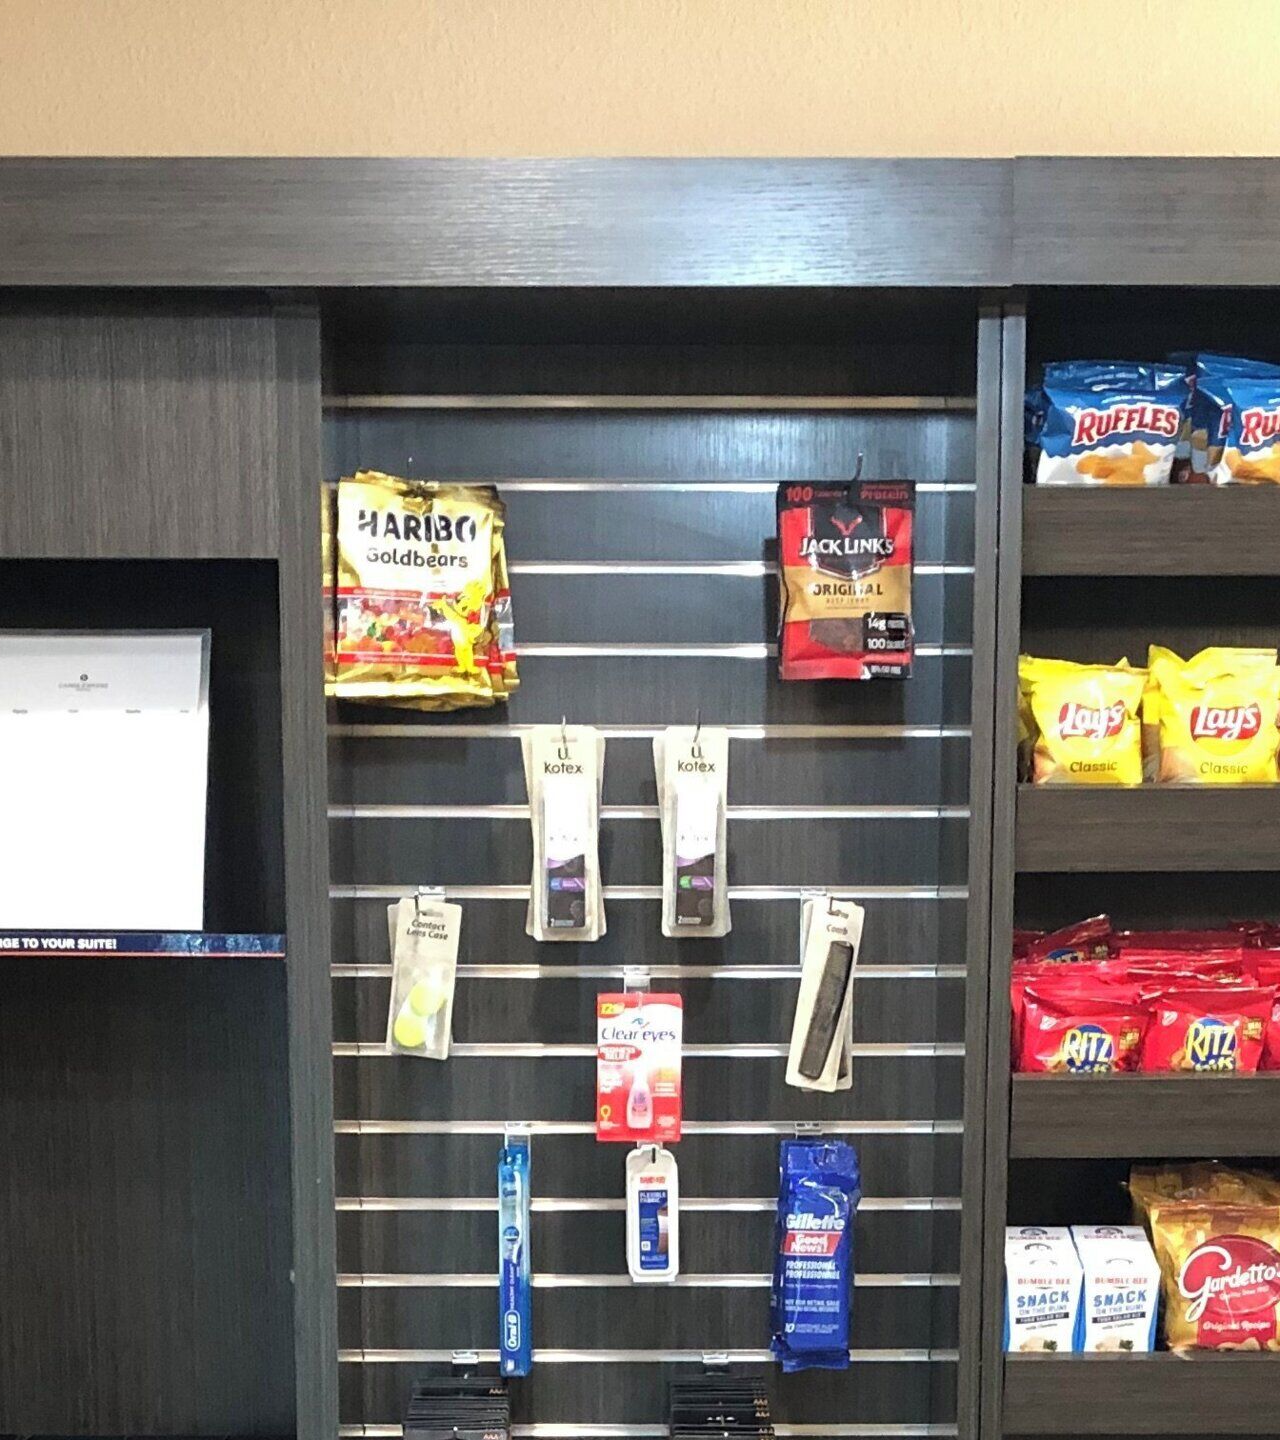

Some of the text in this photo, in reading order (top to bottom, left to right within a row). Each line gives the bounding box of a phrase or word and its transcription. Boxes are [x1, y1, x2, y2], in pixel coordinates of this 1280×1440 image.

[1074, 405, 1180, 445] RUFFLES
[357, 509, 477, 543] HARIBO
[800, 537, 842, 556] JACK
[366, 547, 469, 569] Goldbears
[813, 583, 884, 597] ORIGIAL
[867, 638, 886, 650] 100
[557, 747, 569, 760] U
[691, 746, 702, 759] U
[544, 762, 584, 774] kotex
[677, 760, 716, 773] kotex
[1070, 761, 1118, 773] Classic
[1200, 762, 1248, 774] Classic
[411, 919, 446, 932] Contact
[428, 930, 449, 941] Case
[22, 938, 39, 949] TO
[41, 938, 75, 949] YOUR
[77, 938, 117, 950] SUITE!
[601, 1027, 676, 1042] Clear eyes
[1063, 1028, 1114, 1065] RITZ
[1186, 1022, 1236, 1062] RITZ
[786, 1212, 846, 1231] Gillette
[795, 1233, 829, 1244] Good
[791, 1242, 828, 1253] News!
[1016, 1290, 1070, 1308] SNACK
[1093, 1290, 1147, 1308] SNACK
